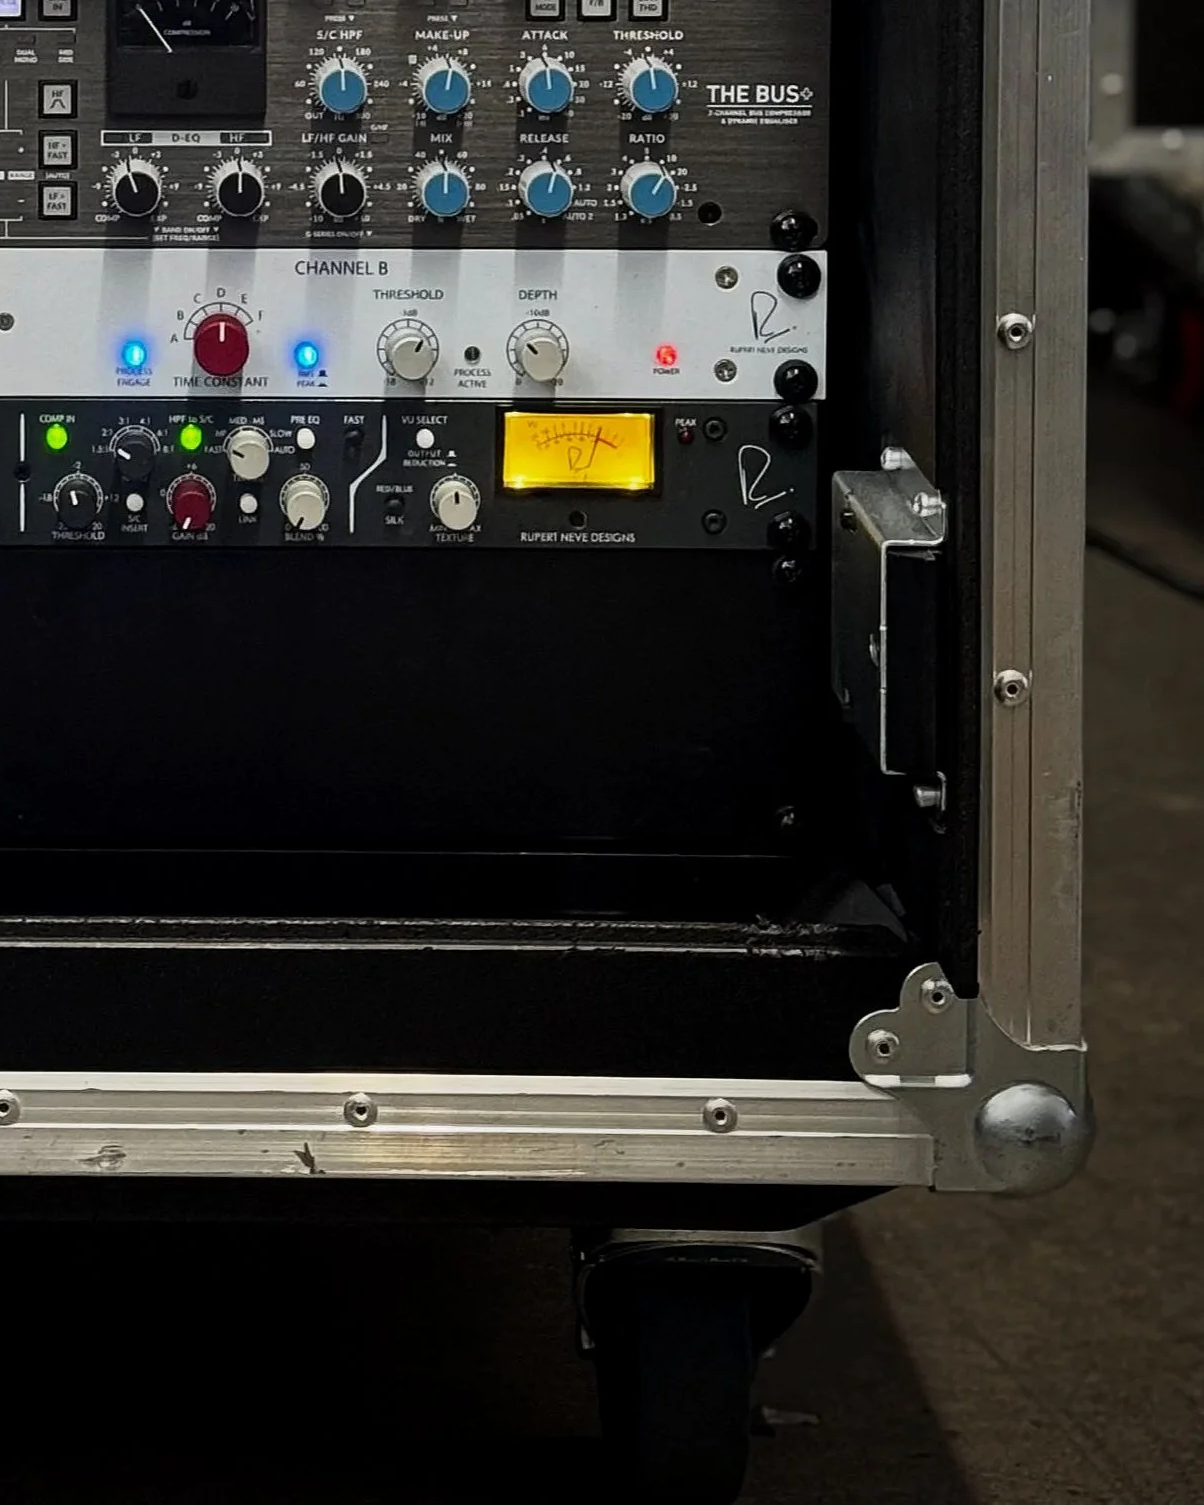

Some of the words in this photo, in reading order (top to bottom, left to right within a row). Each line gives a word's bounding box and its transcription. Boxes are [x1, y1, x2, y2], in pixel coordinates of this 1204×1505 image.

[316, 31, 336, 40] S/C
[340, 31, 363, 40] HPF
[415, 31, 469, 40] MAKE-UP
[522, 31, 568, 40] ATTACK
[614, 31, 684, 40] THRESHOLD
[707, 85, 753, 103] THE
[172, 134, 200, 143] D-EQ
[302, 133, 335, 143] LF/HF
[338, 133, 367, 143] GAIN
[431, 133, 453, 143] MIX
[520, 134, 569, 143] RELEASE
[629, 134, 665, 143] RATIO
[295, 261, 373, 275] CHANNEL
[374, 289, 444, 300] THRESHOLD
[519, 289, 557, 300] DEPTH
[173, 377, 202, 387] TIME
[204, 377, 268, 387] CONSTANT
[40, 415, 62, 423] COMP
[169, 415, 186, 423] HPF
[199, 415, 214, 423] S/C
[416, 416, 448, 425] SELECT
[403, 459, 446, 467] REDUCTION
[521, 532, 557, 542] RUPERT
[560, 532, 588, 542] NEVE
[591, 533, 635, 543] DESIGNS
